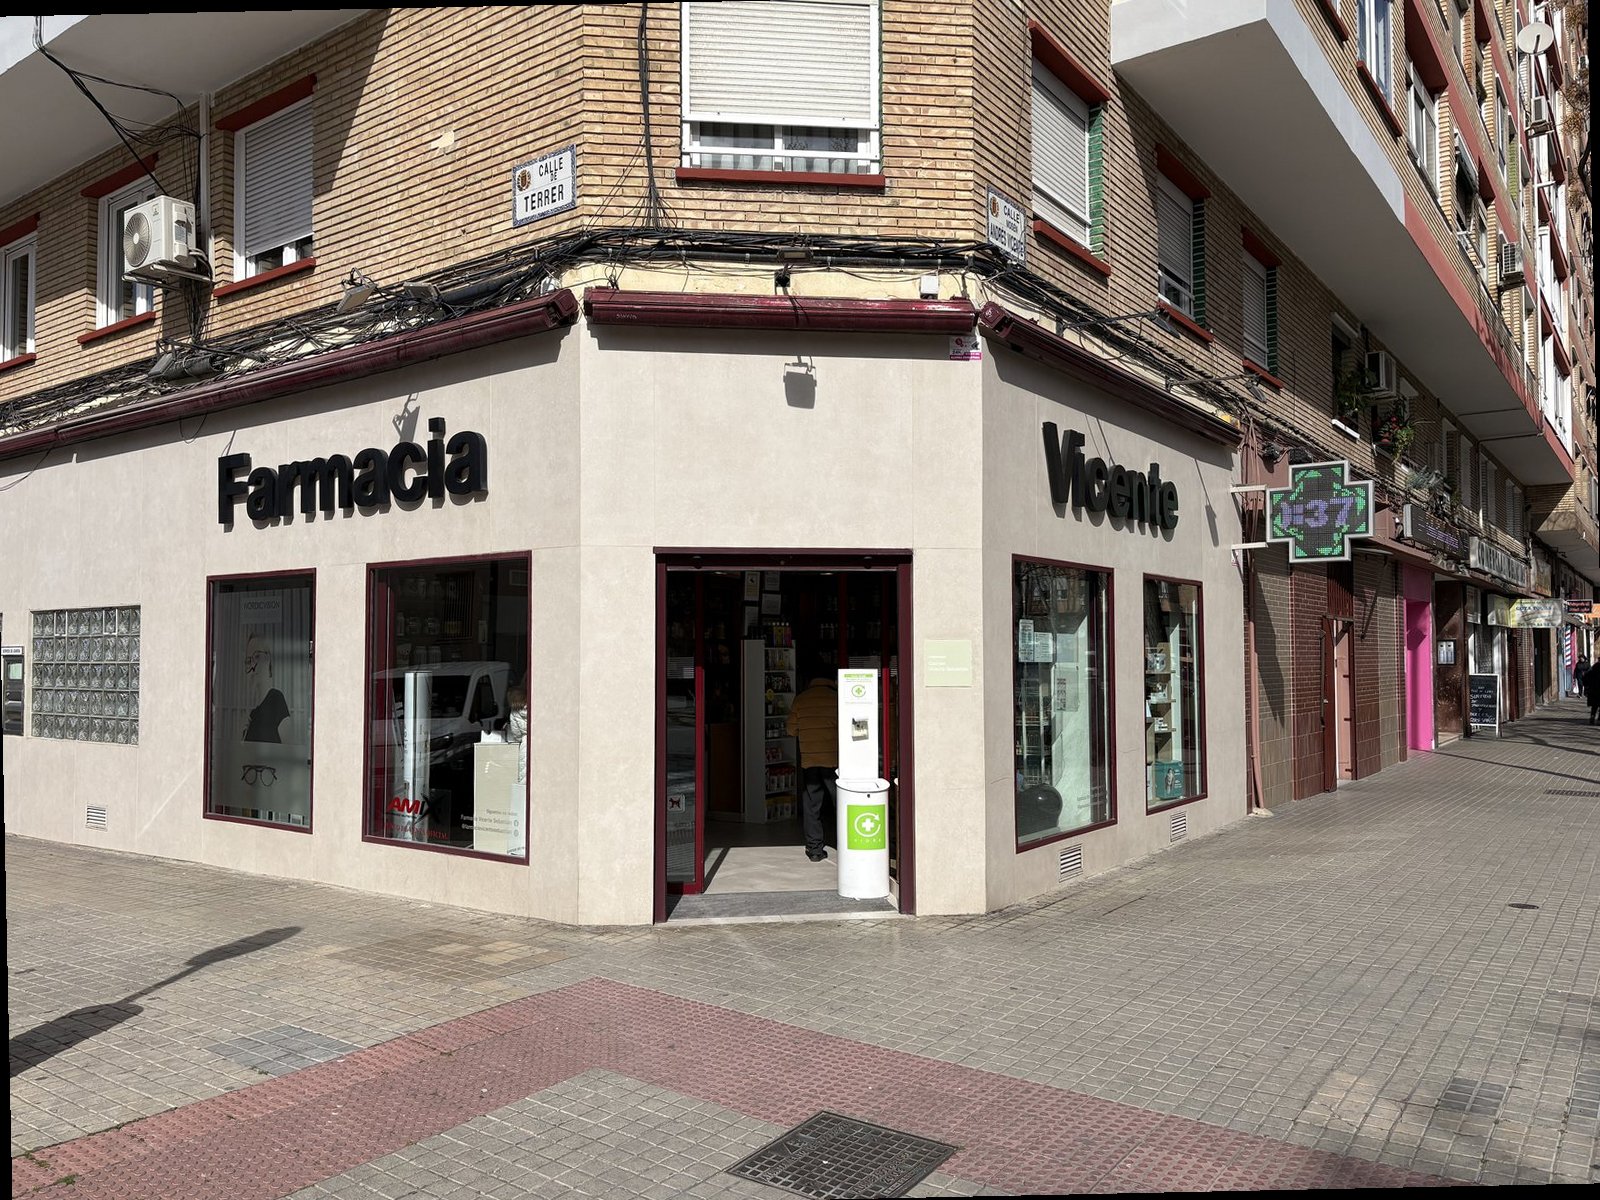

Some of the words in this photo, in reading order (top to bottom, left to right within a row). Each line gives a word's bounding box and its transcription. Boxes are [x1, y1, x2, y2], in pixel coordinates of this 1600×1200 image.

[538, 157, 564, 177] CALLE
[550, 172, 557, 181] DE
[524, 184, 564, 213] TERRER
[1003, 205, 1020, 224] CALLE
[218, 417, 487, 524] Farmacia
[1042, 421, 1179, 530] Vicente
